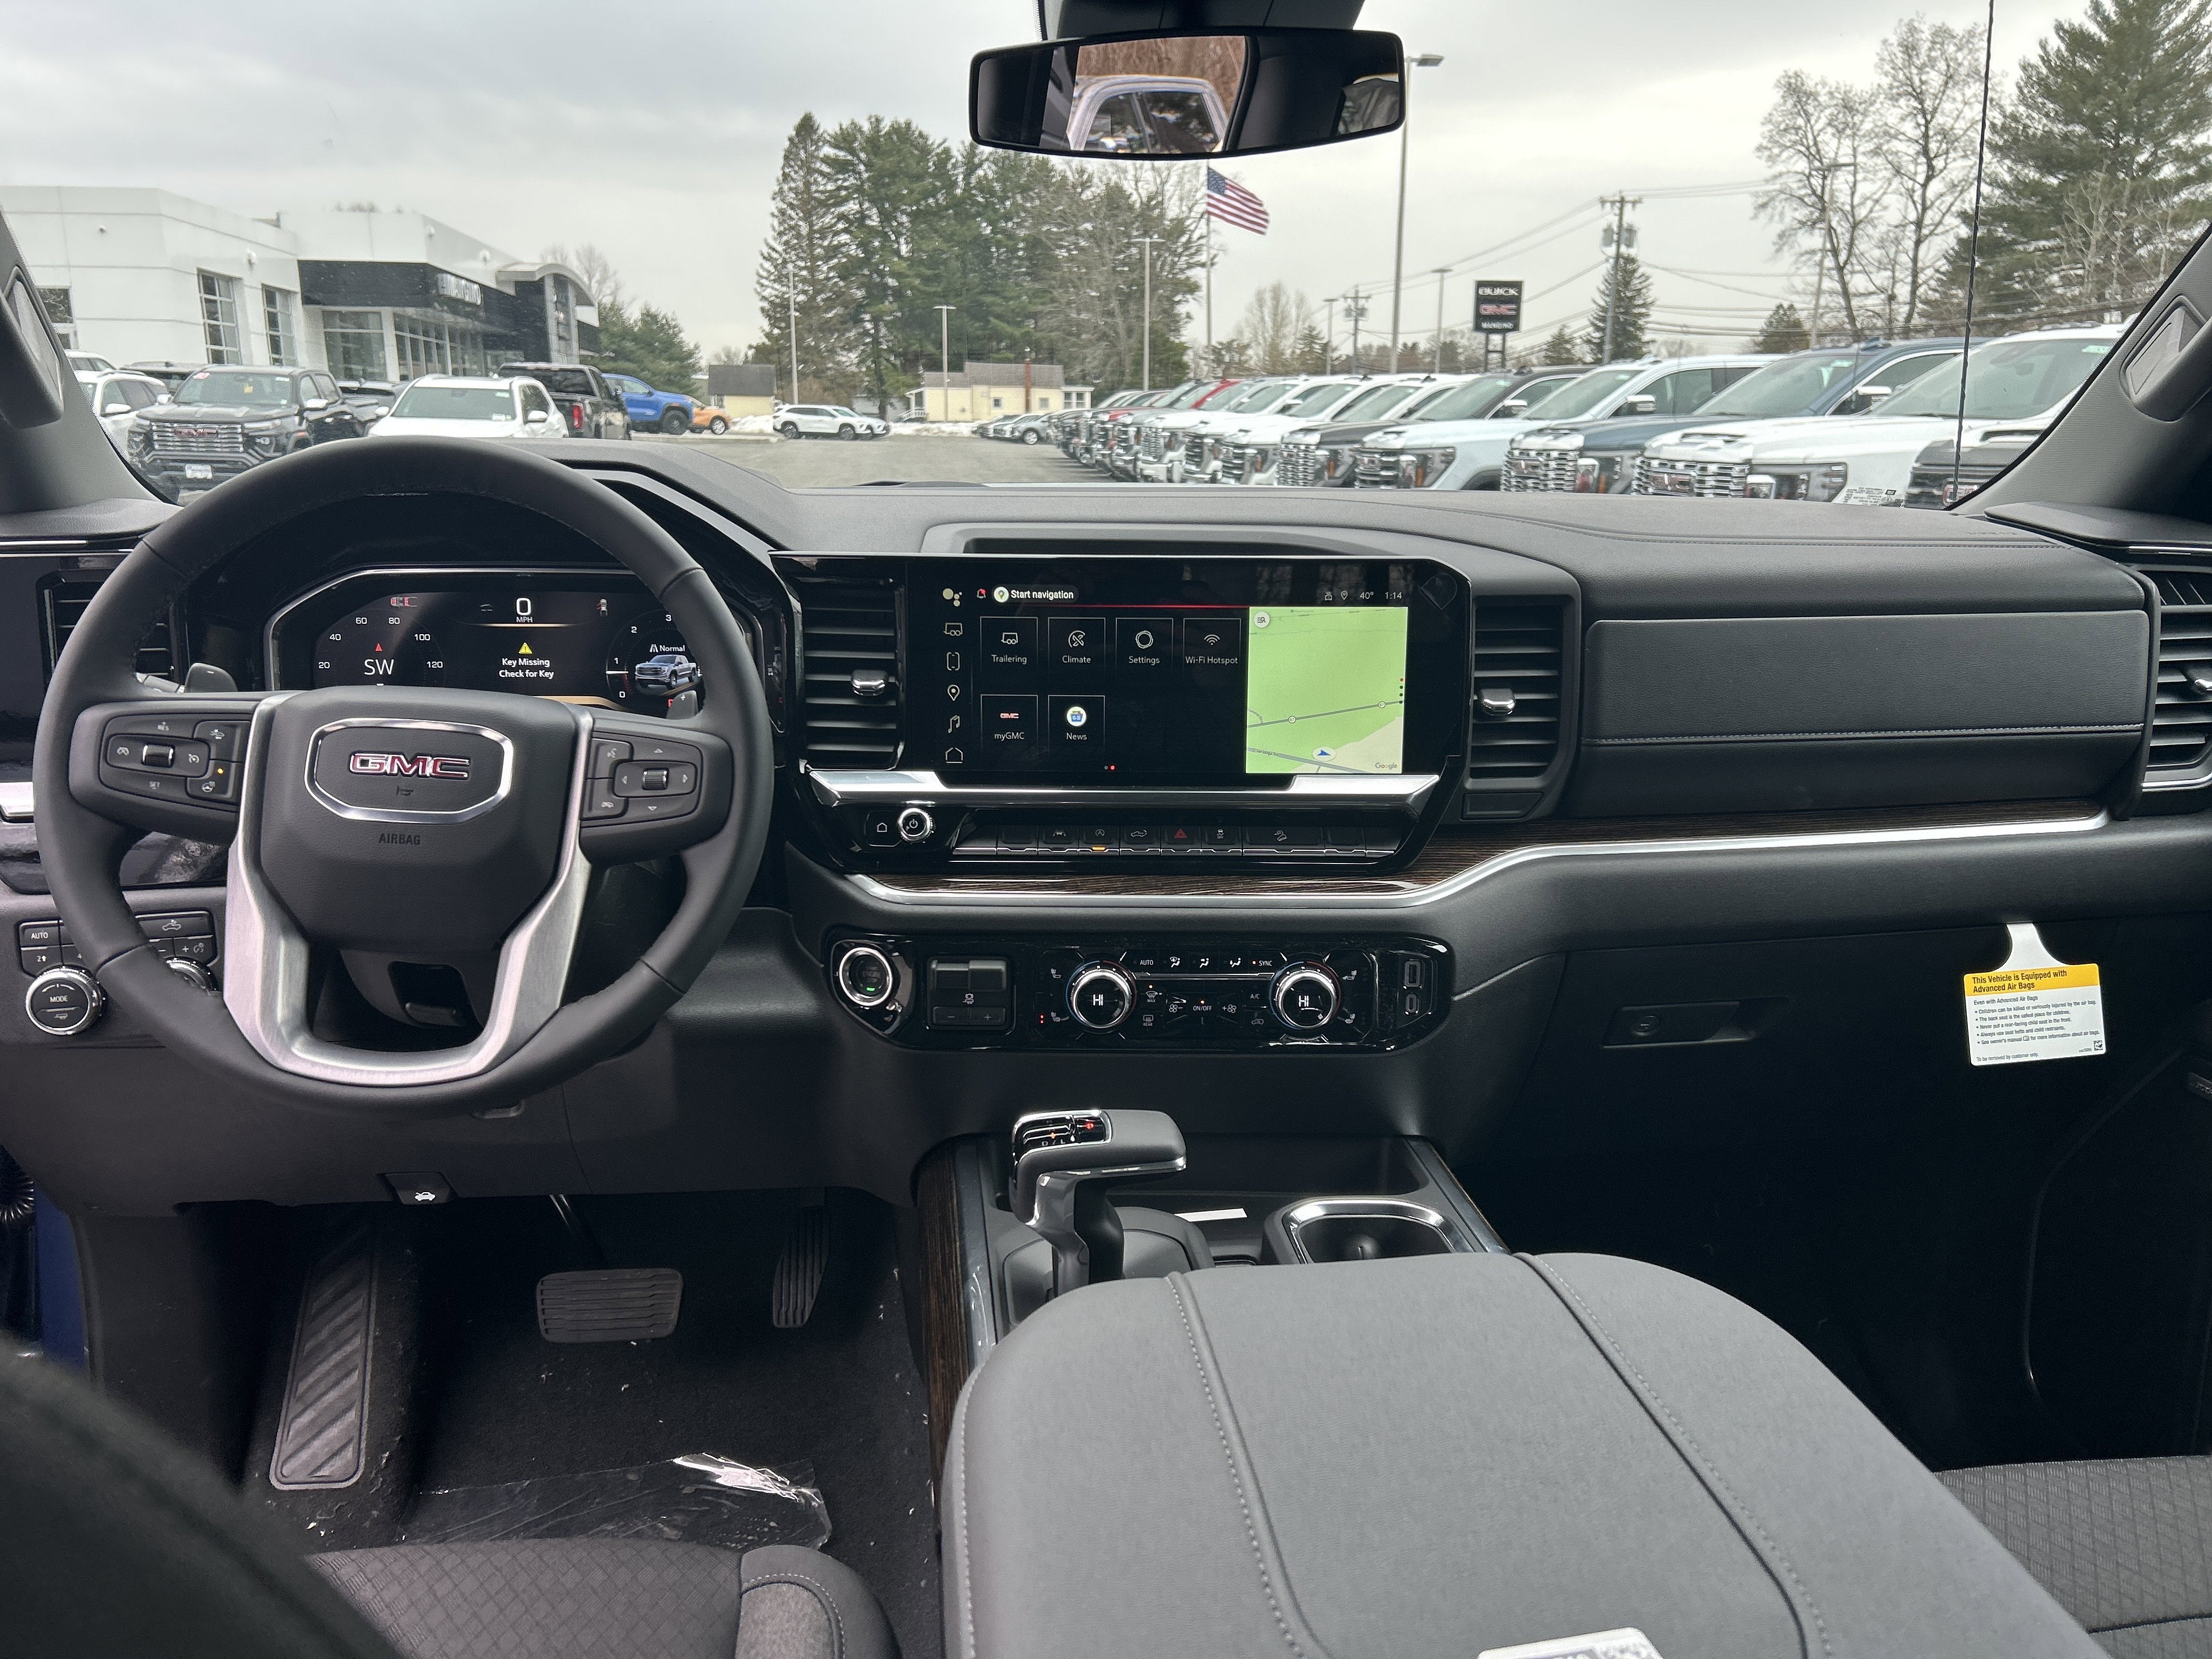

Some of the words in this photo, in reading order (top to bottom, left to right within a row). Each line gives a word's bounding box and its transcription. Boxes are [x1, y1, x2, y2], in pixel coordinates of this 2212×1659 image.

[1479, 304, 1517, 315] GMC
[1011, 590, 1030, 599] Start
[1032, 590, 1074, 601] navigation
[1359, 591, 1374, 600] 40°
[1385, 591, 1402, 600] 1:14
[516, 597, 531, 616] 0
[501, 658, 517, 668] Key
[518, 658, 550, 668] Missing
[991, 654, 1027, 665] Trailering
[1062, 655, 1091, 664] Climate
[1128, 656, 1160, 666] Settings
[1185, 656, 1205, 664] Wi-Fi
[1207, 656, 1238, 665] Hotspot
[364, 658, 394, 675] SW
[499, 669, 524, 678] Check
[539, 670, 554, 679] Key
[994, 732, 1025, 741] myGMC
[349, 753, 470, 779] GMC
[1375, 762, 1398, 770] Google
[379, 833, 421, 845] AIRBAG
[1988, 974, 2012, 983] Vehicle
[2021, 971, 2051, 981] Equipped
[2053, 969, 2067, 978] with
[1973, 983, 2006, 994] Advanced
[2018, 981, 2035, 990] Bags
[1093, 994, 1103, 1006] HI
[1299, 995, 1309, 1007] HI
